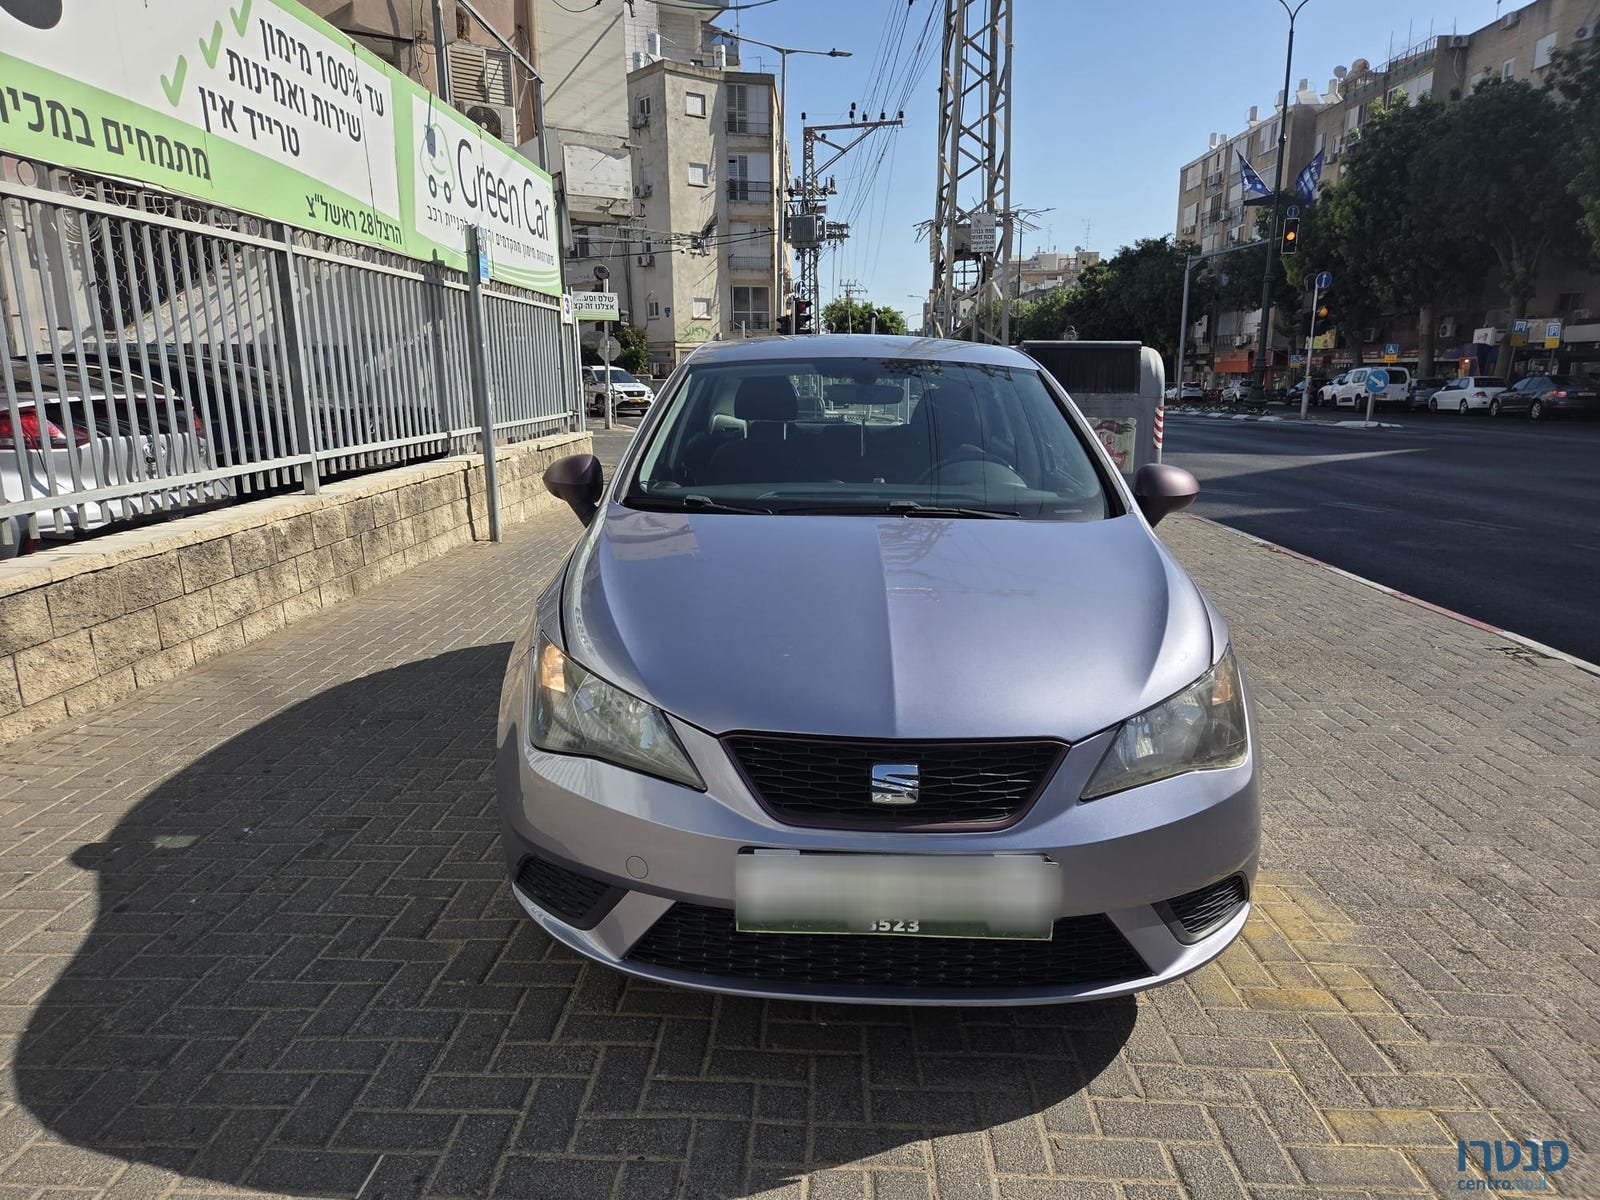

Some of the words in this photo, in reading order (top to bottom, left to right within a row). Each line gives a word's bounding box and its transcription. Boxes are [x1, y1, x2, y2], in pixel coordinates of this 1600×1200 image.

[259, 17, 312, 76] מימון
[226, 48, 308, 116] ואמינות
[317, 51, 362, 104] 100%
[365, 83, 384, 117] עד
[198, 86, 238, 133] אין
[242, 105, 300, 157] טרייד
[311, 93, 362, 142] שירות
[101, 117, 211, 181] מתמחים
[457, 138, 521, 229] Green
[523, 178, 549, 241] Car
[359, 210, 375, 236] 28
[376, 215, 402, 245] הרצל
[427, 205, 443, 224] רכב
[598, 294, 614, 302] שלם
